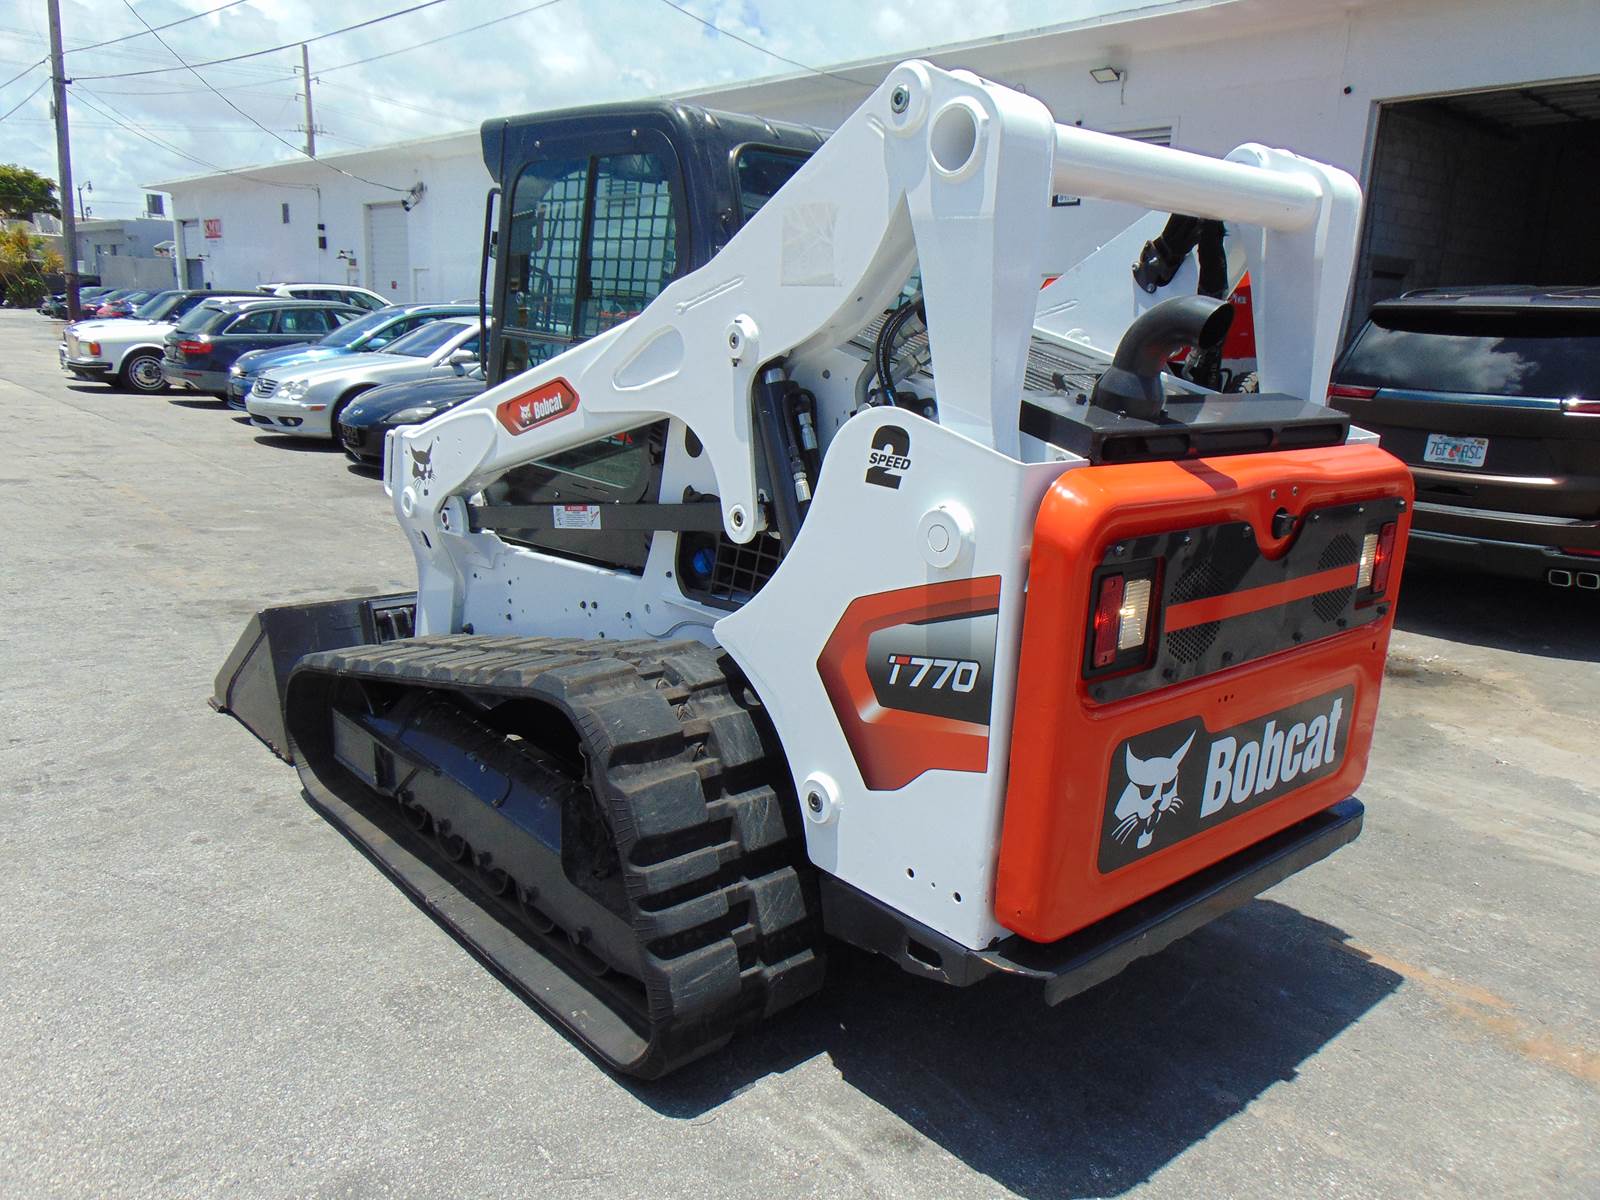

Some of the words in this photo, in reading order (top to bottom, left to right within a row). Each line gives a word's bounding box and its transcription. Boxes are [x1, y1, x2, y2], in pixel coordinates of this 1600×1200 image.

[533, 392, 563, 419] Bobcat
[865, 425, 910, 490] 2
[869, 452, 911, 470] SPEED
[888, 655, 980, 693] T770
[1200, 697, 1343, 818] Bobcat
